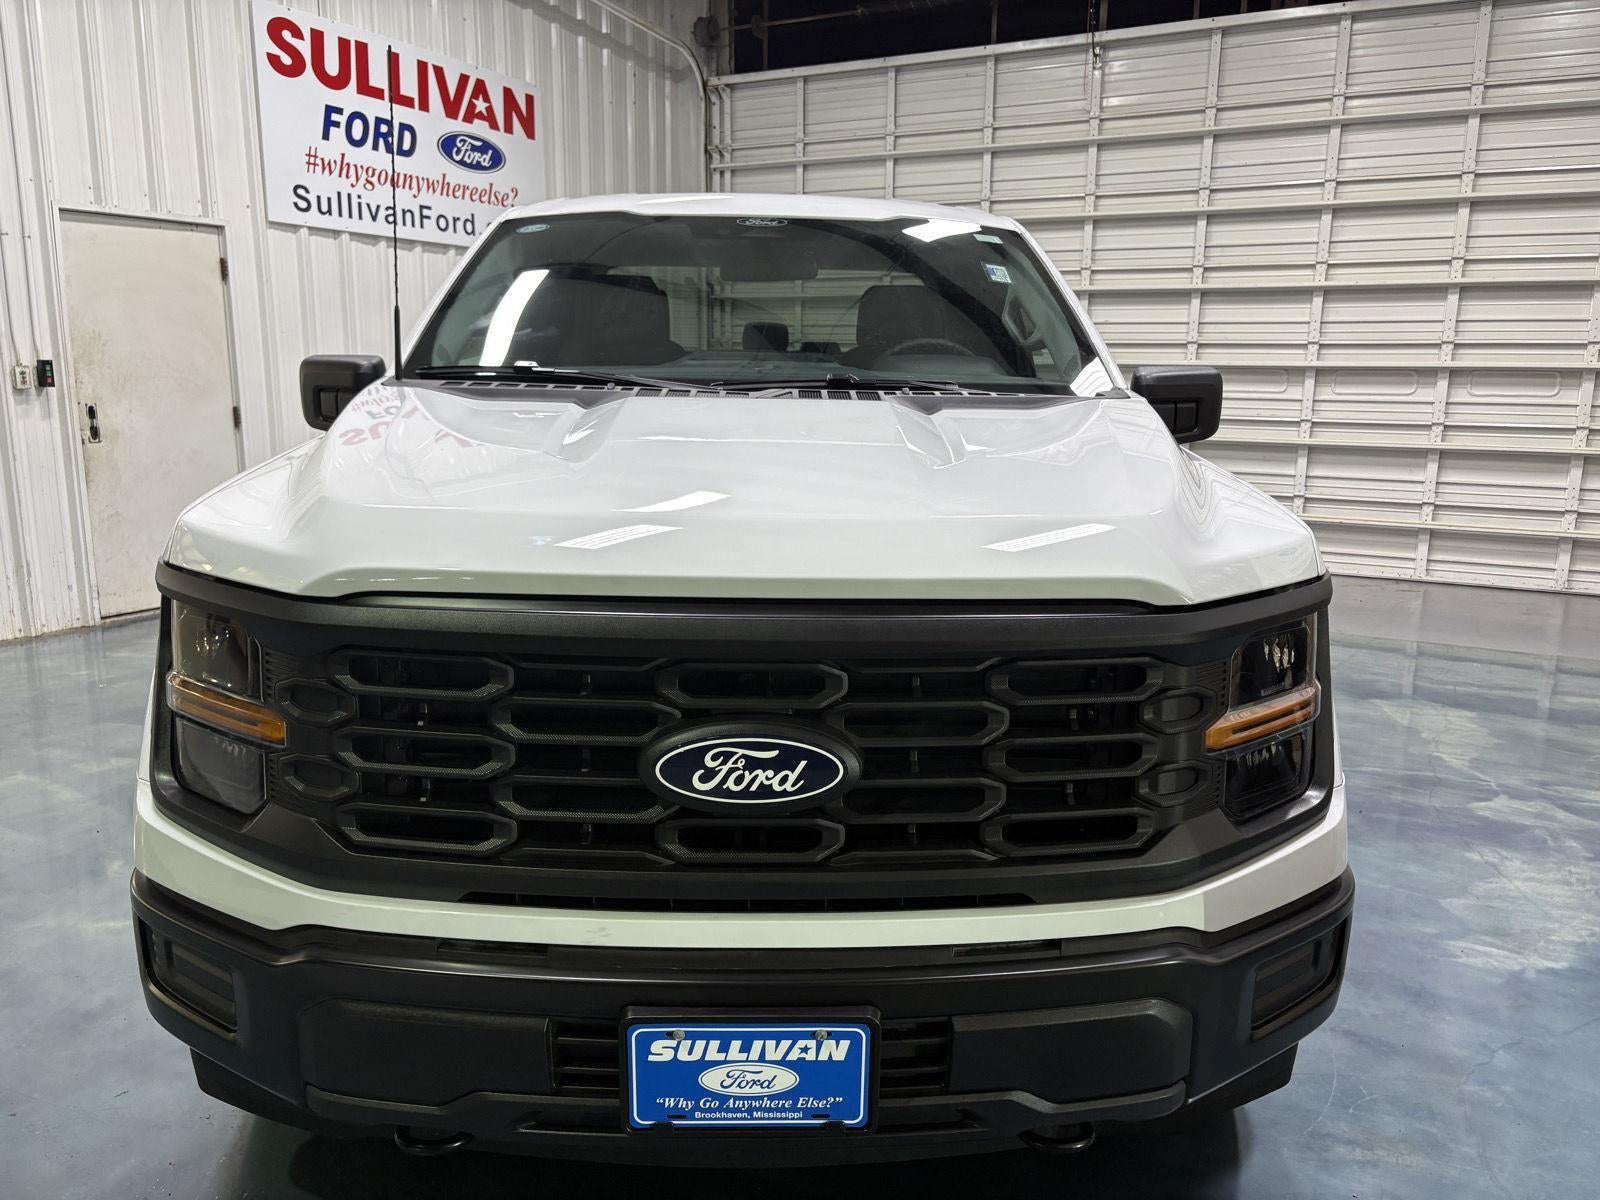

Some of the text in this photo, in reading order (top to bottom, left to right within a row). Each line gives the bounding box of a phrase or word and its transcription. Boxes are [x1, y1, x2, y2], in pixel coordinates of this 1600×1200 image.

[266, 16, 536, 141] SULLIVAN
[321, 104, 418, 158] FORD
[451, 136, 492, 168] Ford
[305, 146, 519, 208] #whygoanywhereelse?
[293, 184, 492, 237] SullivanFord.
[692, 747, 808, 792] Ford
[648, 1039, 851, 1062] SULLIVAN
[720, 1069, 777, 1090] Ford
[694, 1110, 803, 1120] Brookhaven, Mississippi
[700, 1097, 719, 1109] Go
[723, 1097, 793, 1110] Anywhere
